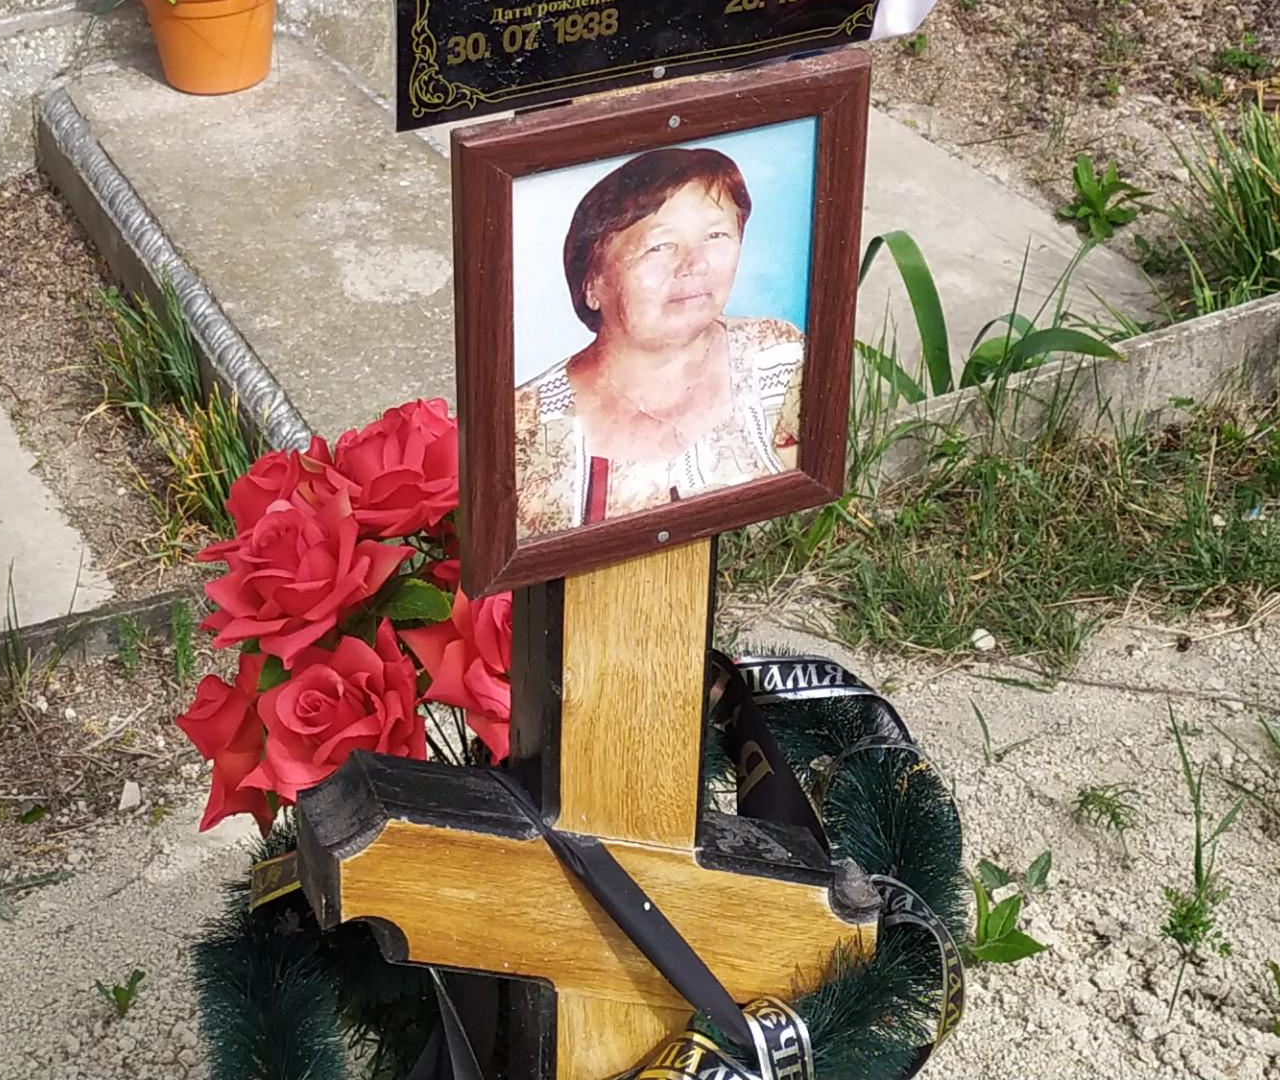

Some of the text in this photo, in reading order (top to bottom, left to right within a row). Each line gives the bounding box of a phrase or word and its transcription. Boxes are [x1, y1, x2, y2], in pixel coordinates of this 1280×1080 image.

[489, 7, 532, 25] Дата
[447, 32, 491, 66] 30.
[553, 7, 619, 44] 1938
